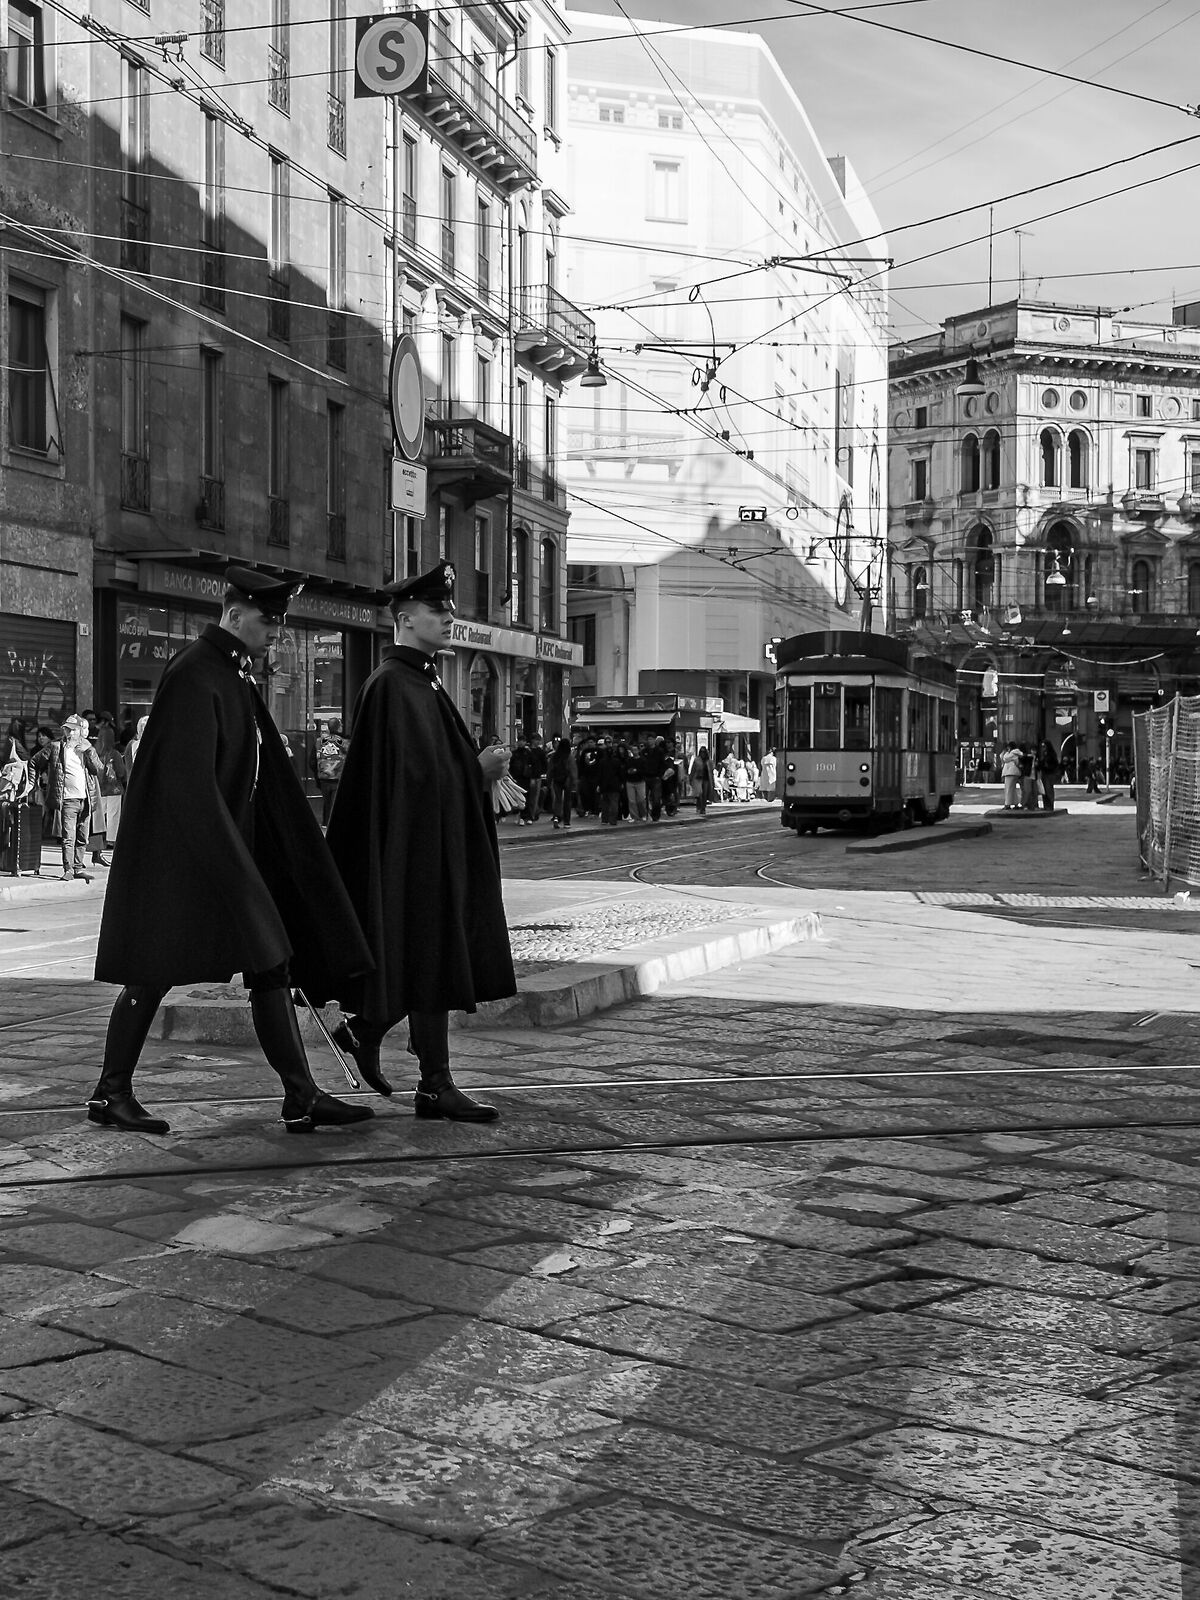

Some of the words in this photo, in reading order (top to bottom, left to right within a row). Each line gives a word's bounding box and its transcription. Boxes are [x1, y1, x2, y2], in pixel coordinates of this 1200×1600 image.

[376, 30, 406, 82] S
[164, 571, 193, 592] BANCA
[359, 608, 373, 623] LODI
[452, 623, 468, 642] KFC
[542, 641, 555, 658] KFC
[821, 683, 837, 695] 19
